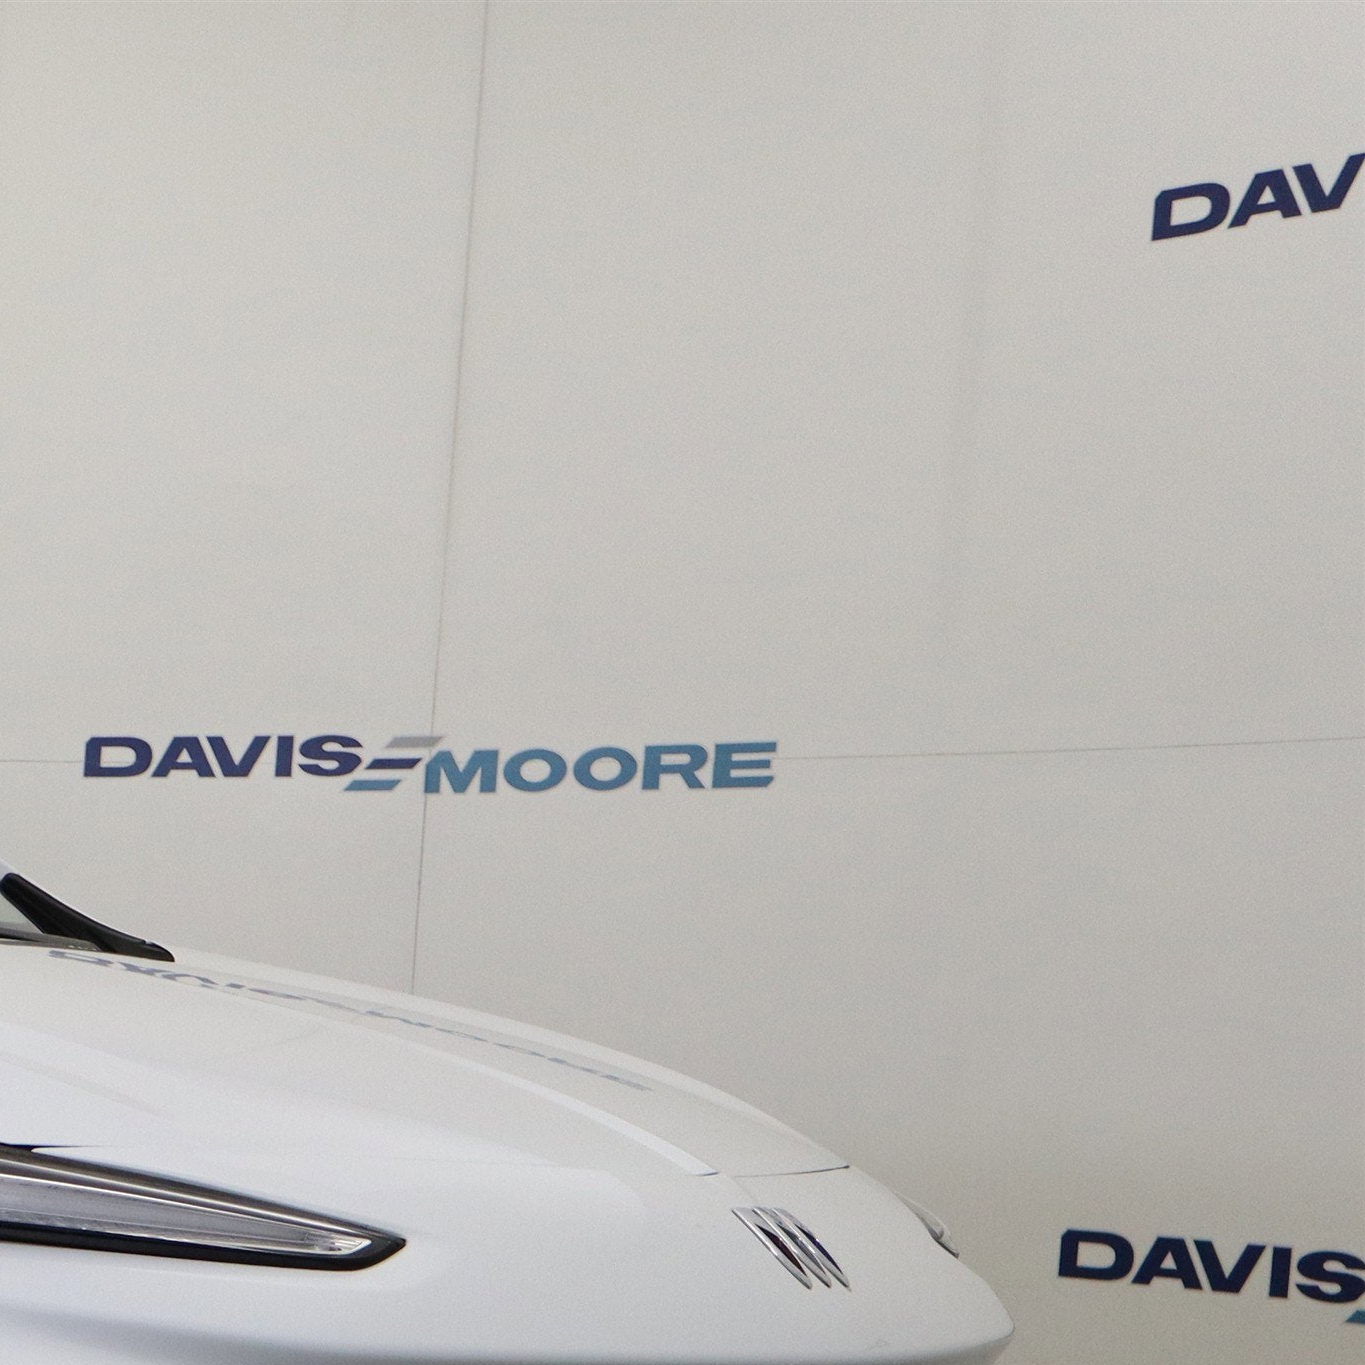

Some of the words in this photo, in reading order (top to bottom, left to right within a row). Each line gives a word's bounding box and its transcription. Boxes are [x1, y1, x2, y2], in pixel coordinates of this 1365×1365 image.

[1150, 152, 1365, 241] DAV
[83, 735, 364, 779] DAVIS
[424, 741, 778, 794] MOORE
[1057, 1228, 1365, 1304] DAVIS
